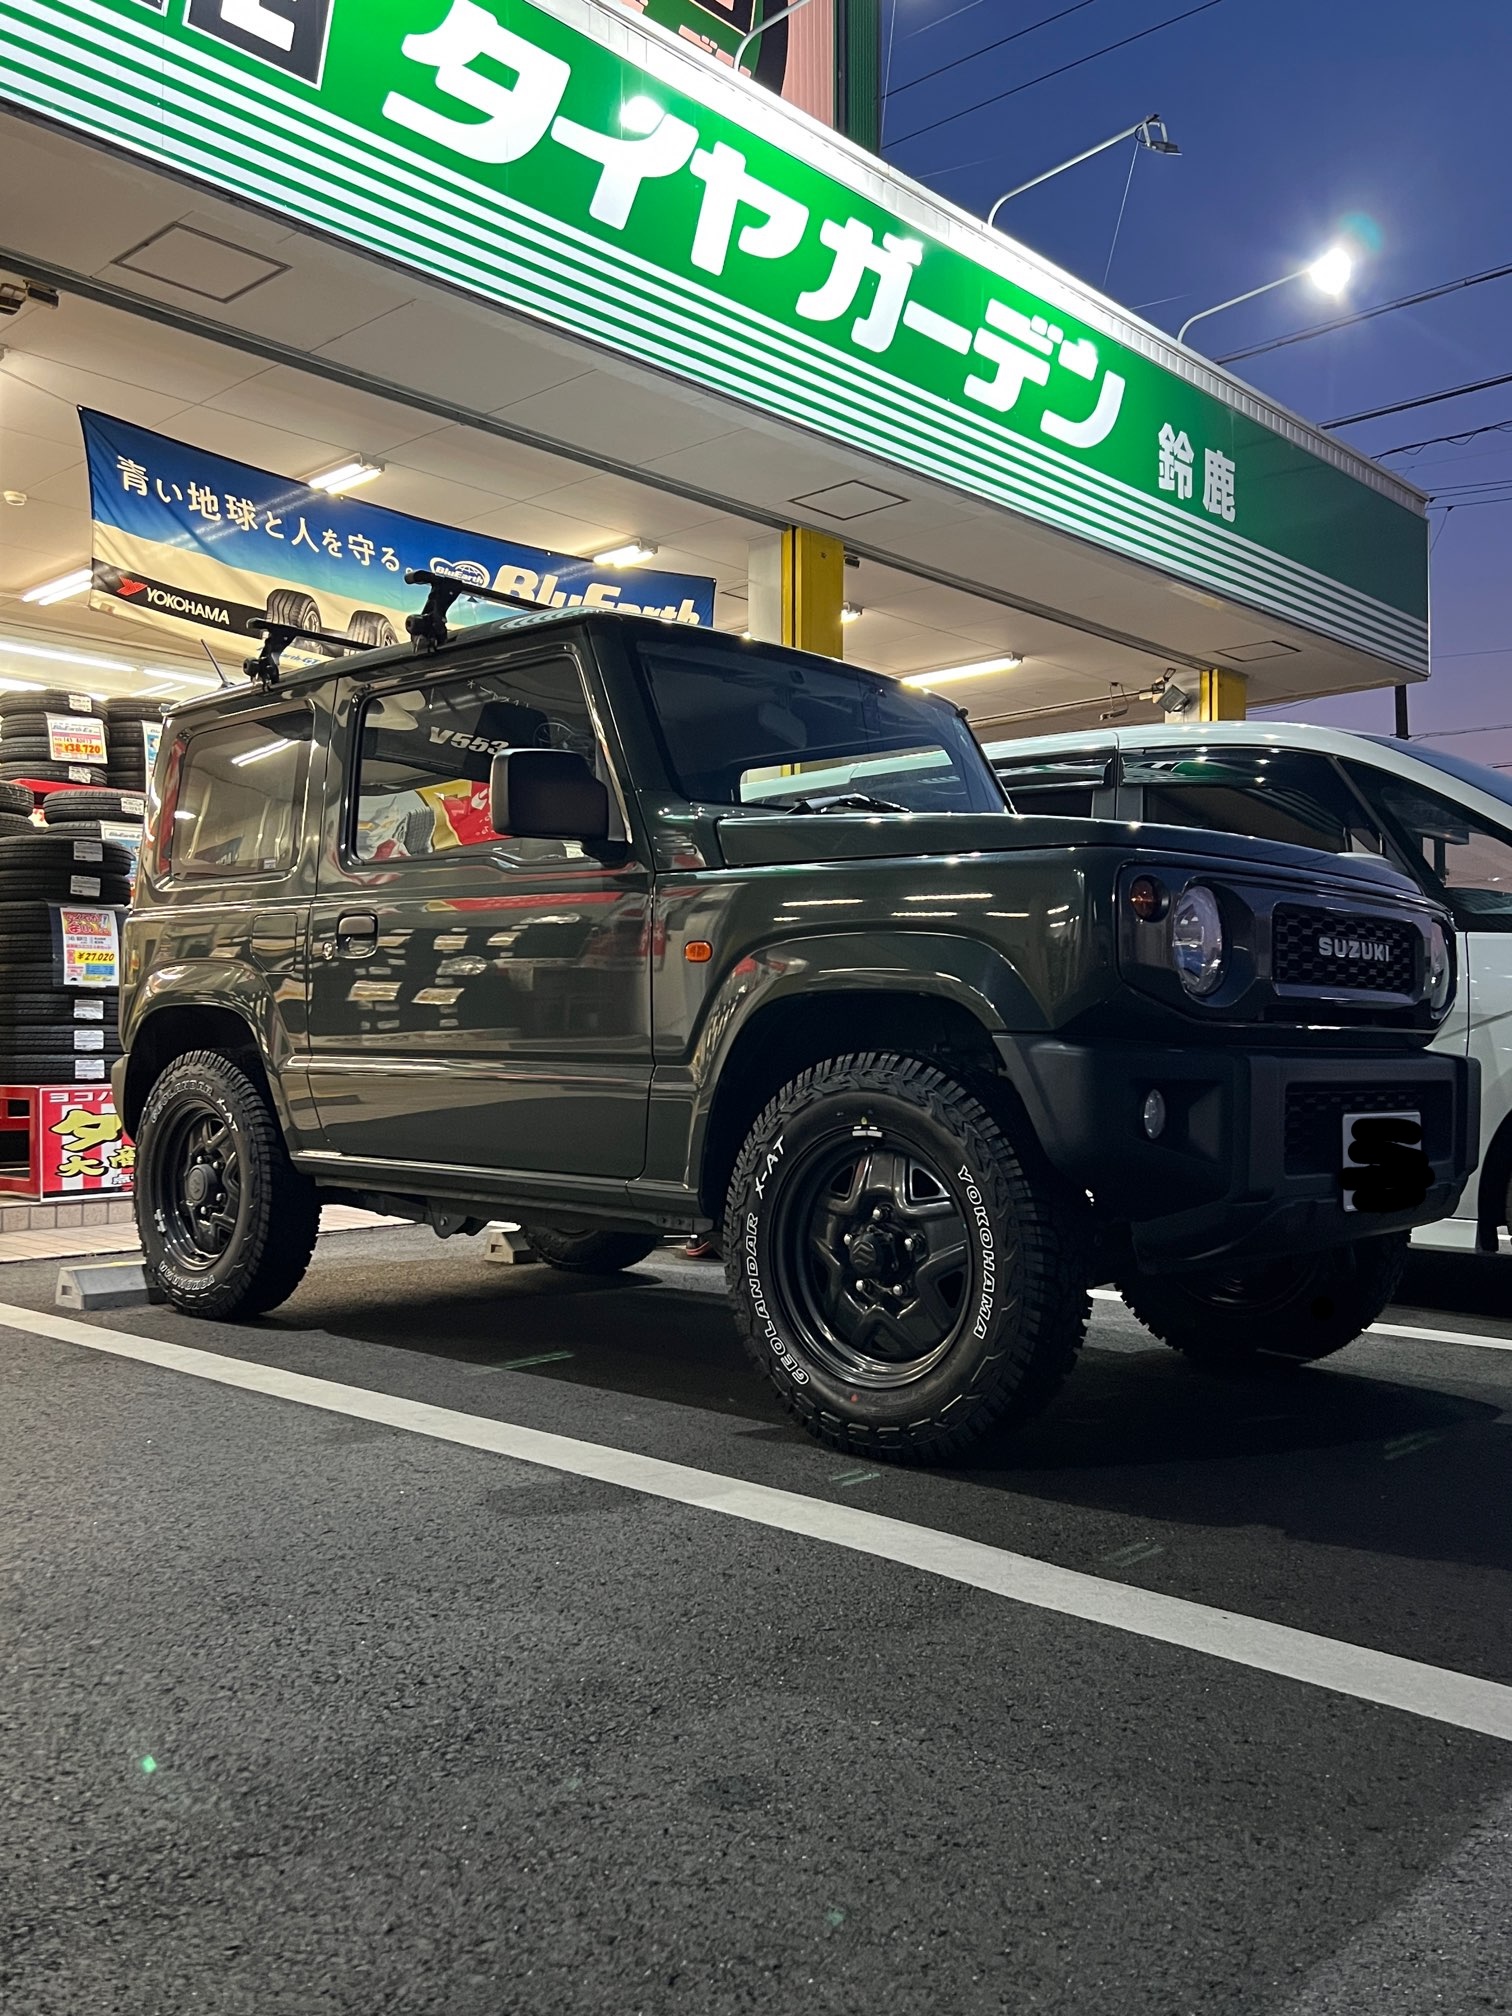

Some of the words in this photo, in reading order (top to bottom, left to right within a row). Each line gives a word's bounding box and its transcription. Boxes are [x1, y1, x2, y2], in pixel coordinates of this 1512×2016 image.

[382, 0, 1126, 449] タイヤガーデン
[116, 455, 414, 575] 青い地球と人を守る。
[1157, 421, 1236, 524] 鈴鹿
[146, 587, 231, 626] YOKOHAMA
[428, 726, 510, 756] V553
[1319, 937, 1390, 962] SUZUKI
[755, 1134, 785, 1200] X-AT
[746, 1212, 810, 1386] GEOLANDAR
[957, 1164, 998, 1340] YOKOHAMA
